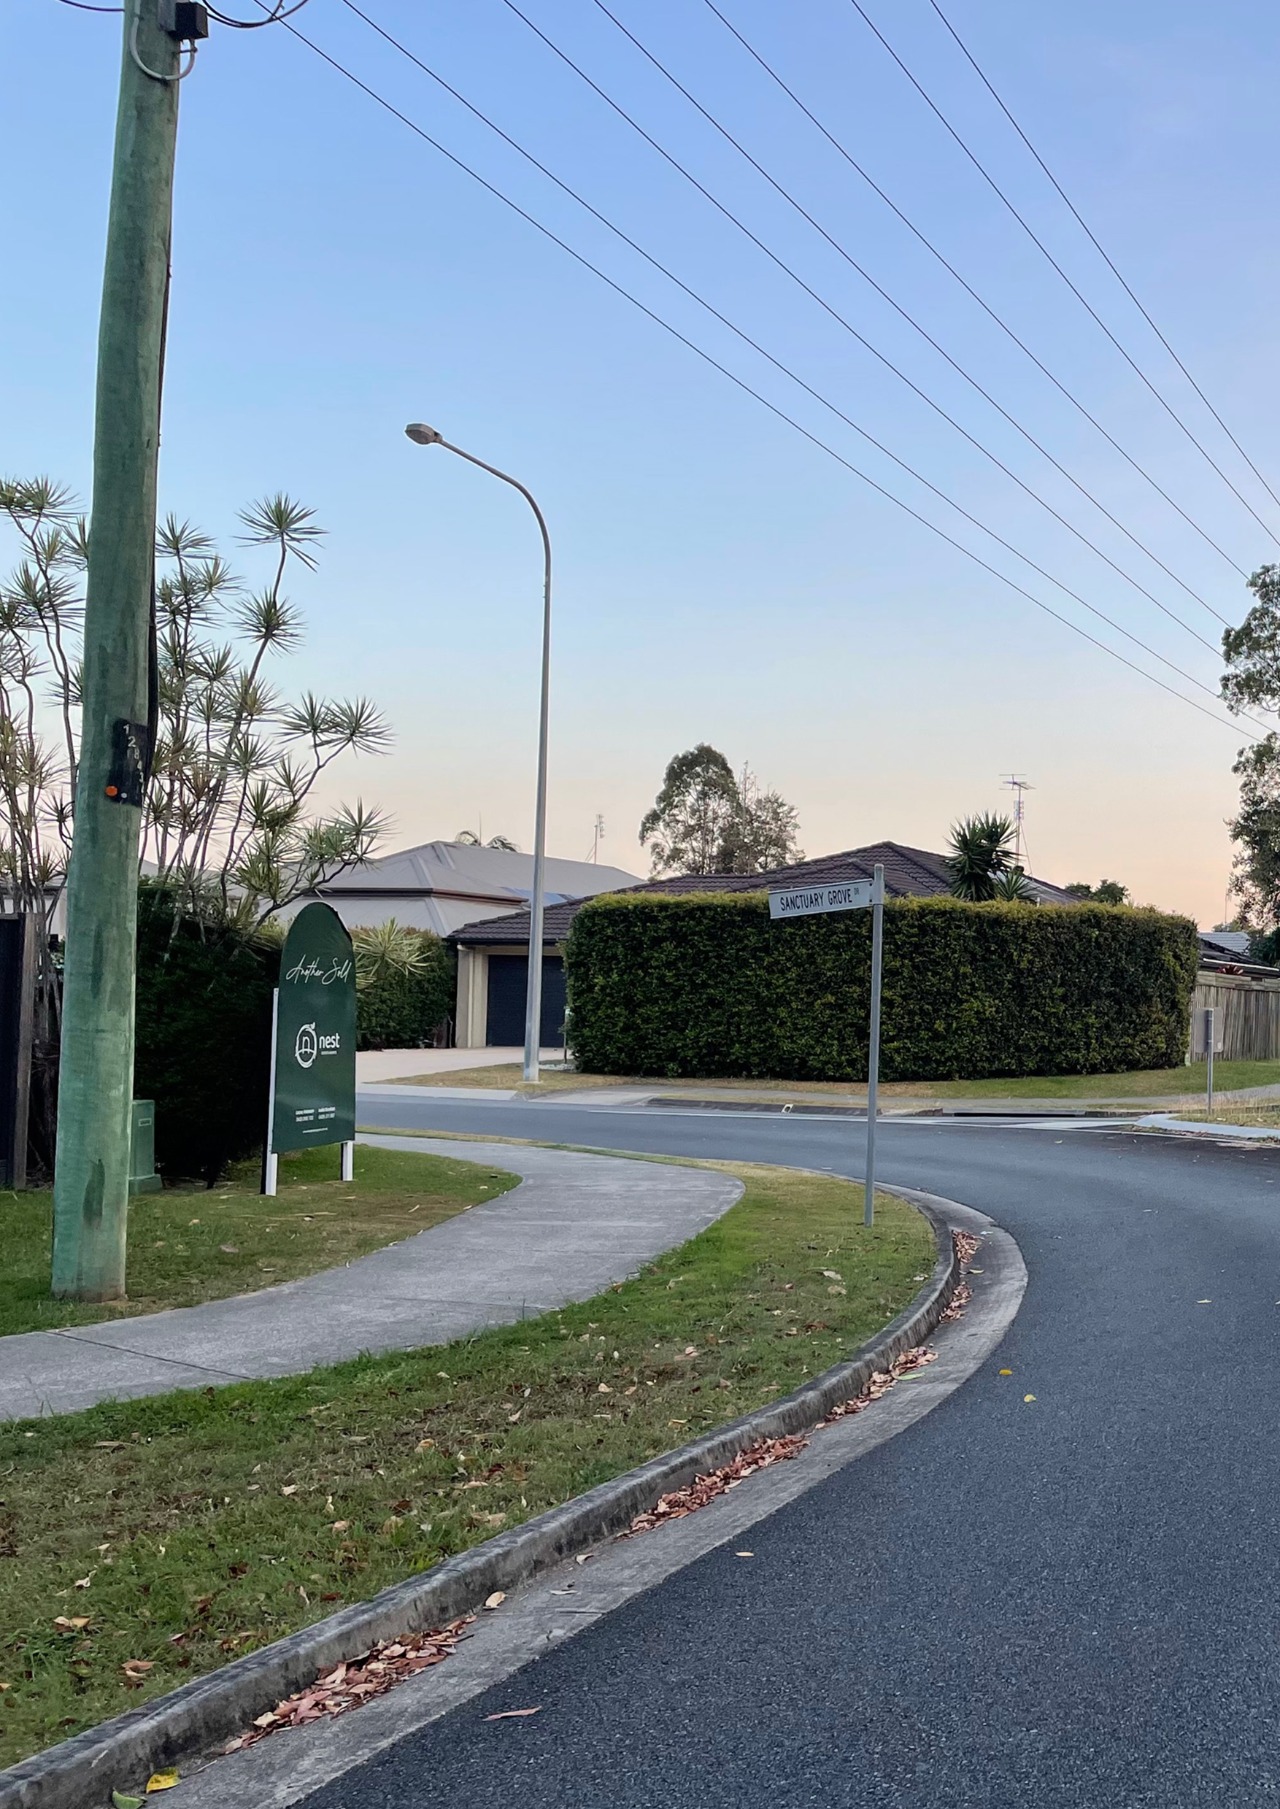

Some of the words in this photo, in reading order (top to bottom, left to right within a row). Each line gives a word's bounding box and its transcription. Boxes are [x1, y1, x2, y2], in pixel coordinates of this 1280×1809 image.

[780, 892, 824, 911] SANCTUARY
[828, 888, 852, 906] GROVE
[286, 954, 324, 984] Another
[321, 957, 352, 985] Sold
[319, 1032, 340, 1049] nest
